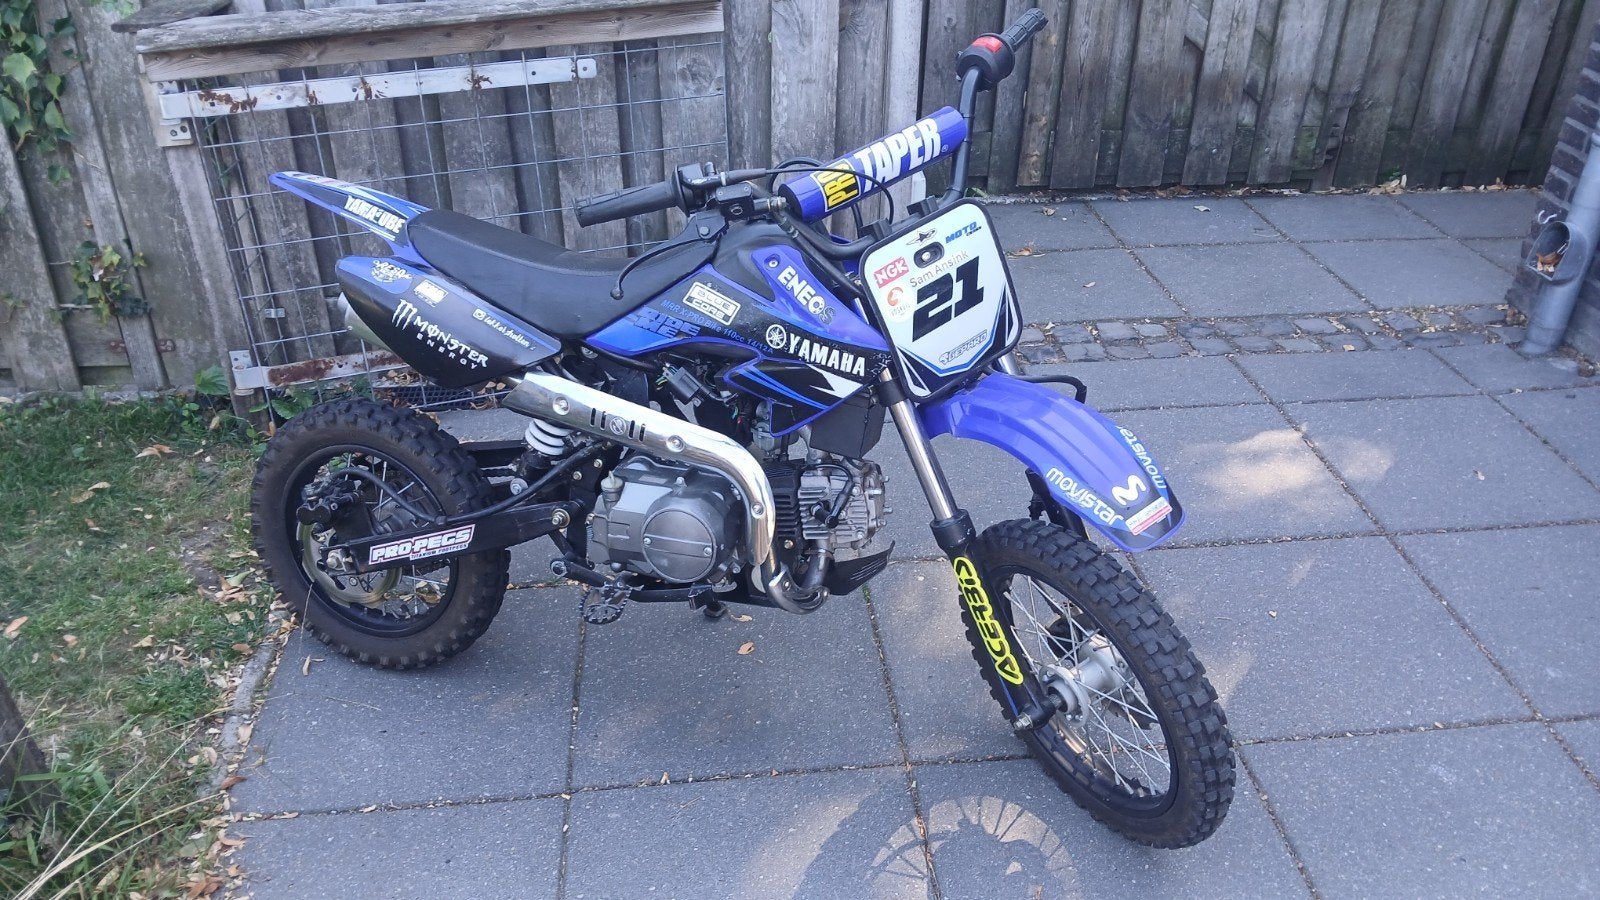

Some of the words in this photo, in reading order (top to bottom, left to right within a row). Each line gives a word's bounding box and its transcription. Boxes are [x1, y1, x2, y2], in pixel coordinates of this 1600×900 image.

[854, 118, 942, 193] TAPER
[945, 222, 978, 244] MOTO
[874, 257, 910, 285] NGK
[909, 271, 934, 289] Sam
[692, 297, 726, 322] CORE
[777, 264, 837, 325] ENEOS
[912, 256, 985, 343] 21
[416, 332, 479, 370] ENERGY
[789, 333, 866, 377] YAMAHA
[1045, 467, 1125, 526] movistar
[954, 557, 1022, 683] ACERBIS
